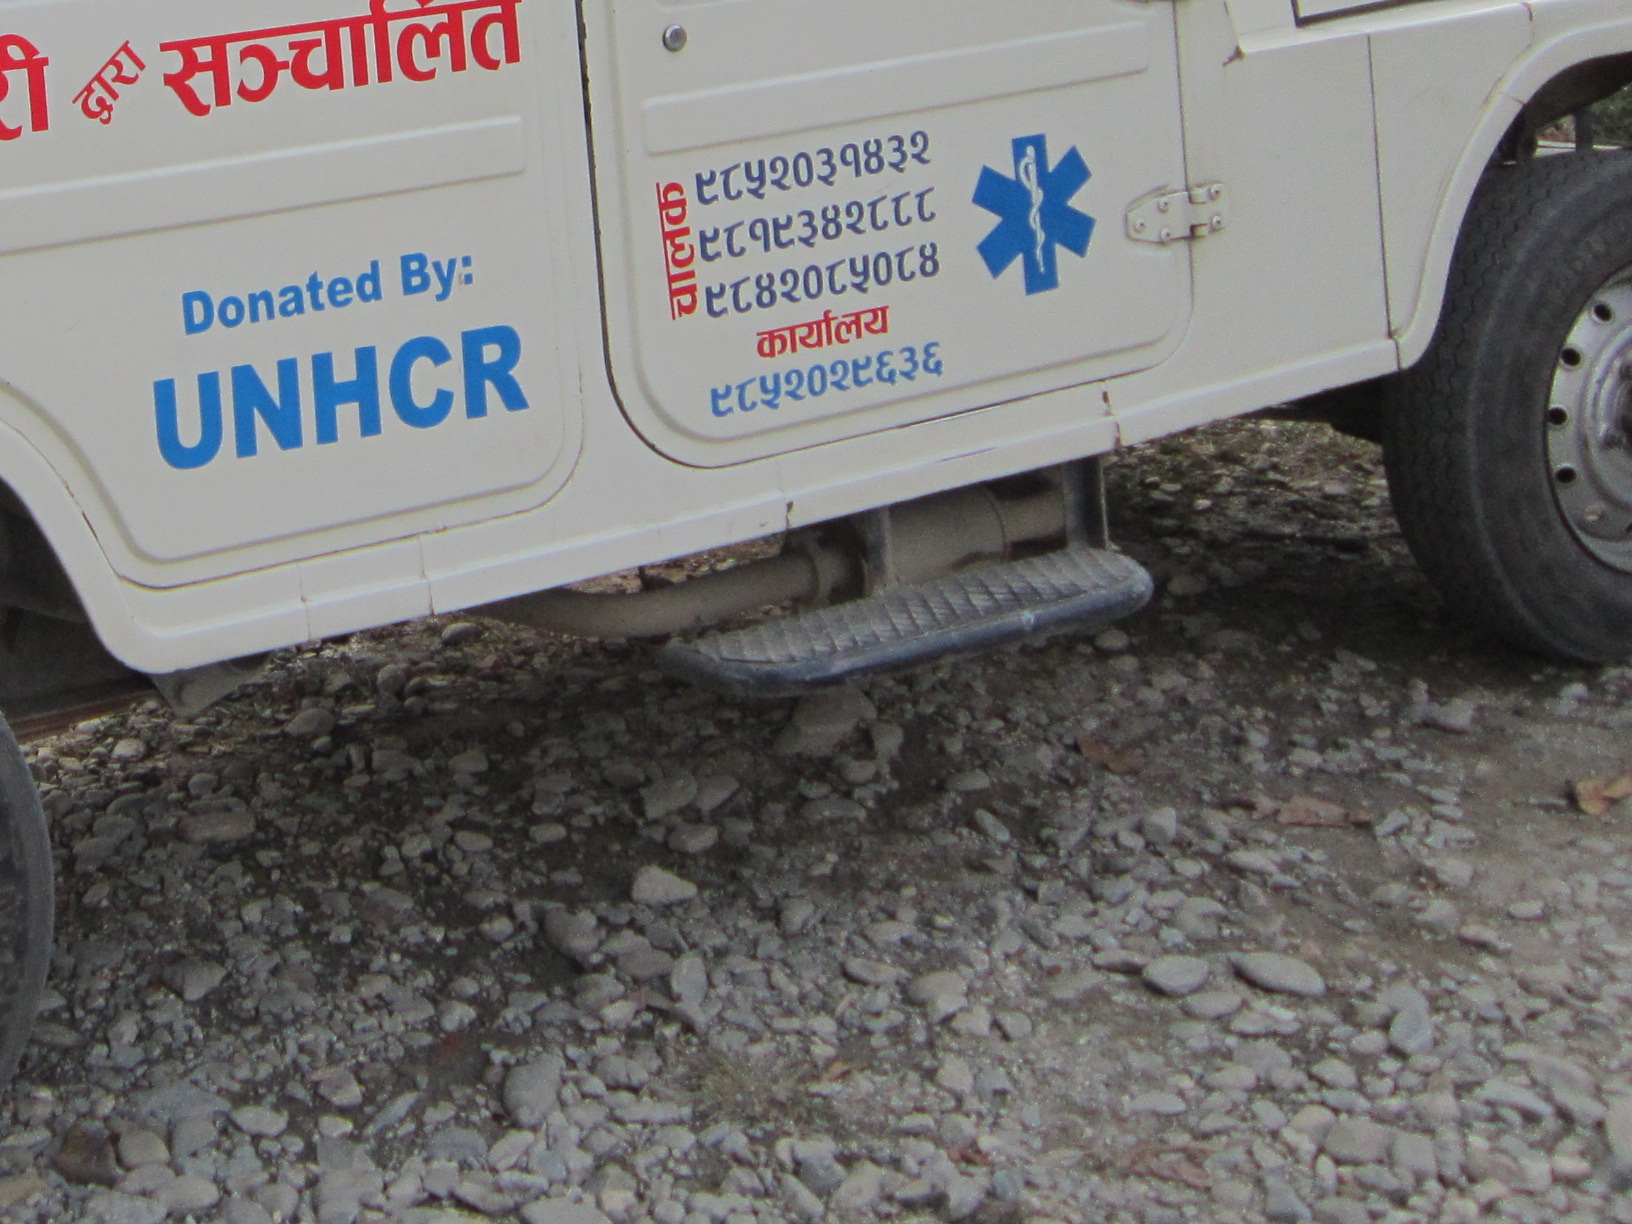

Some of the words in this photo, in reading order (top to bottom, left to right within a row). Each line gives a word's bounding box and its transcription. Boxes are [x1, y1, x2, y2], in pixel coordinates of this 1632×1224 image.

[72, 40, 146, 125] द्वारा
[182, 259, 383, 335] Donated
[400, 252, 474, 302] By:
[656, 182, 698, 320] चालक
[756, 305, 890, 358] कार्यालय
[153, 324, 529, 470] UNHCR
